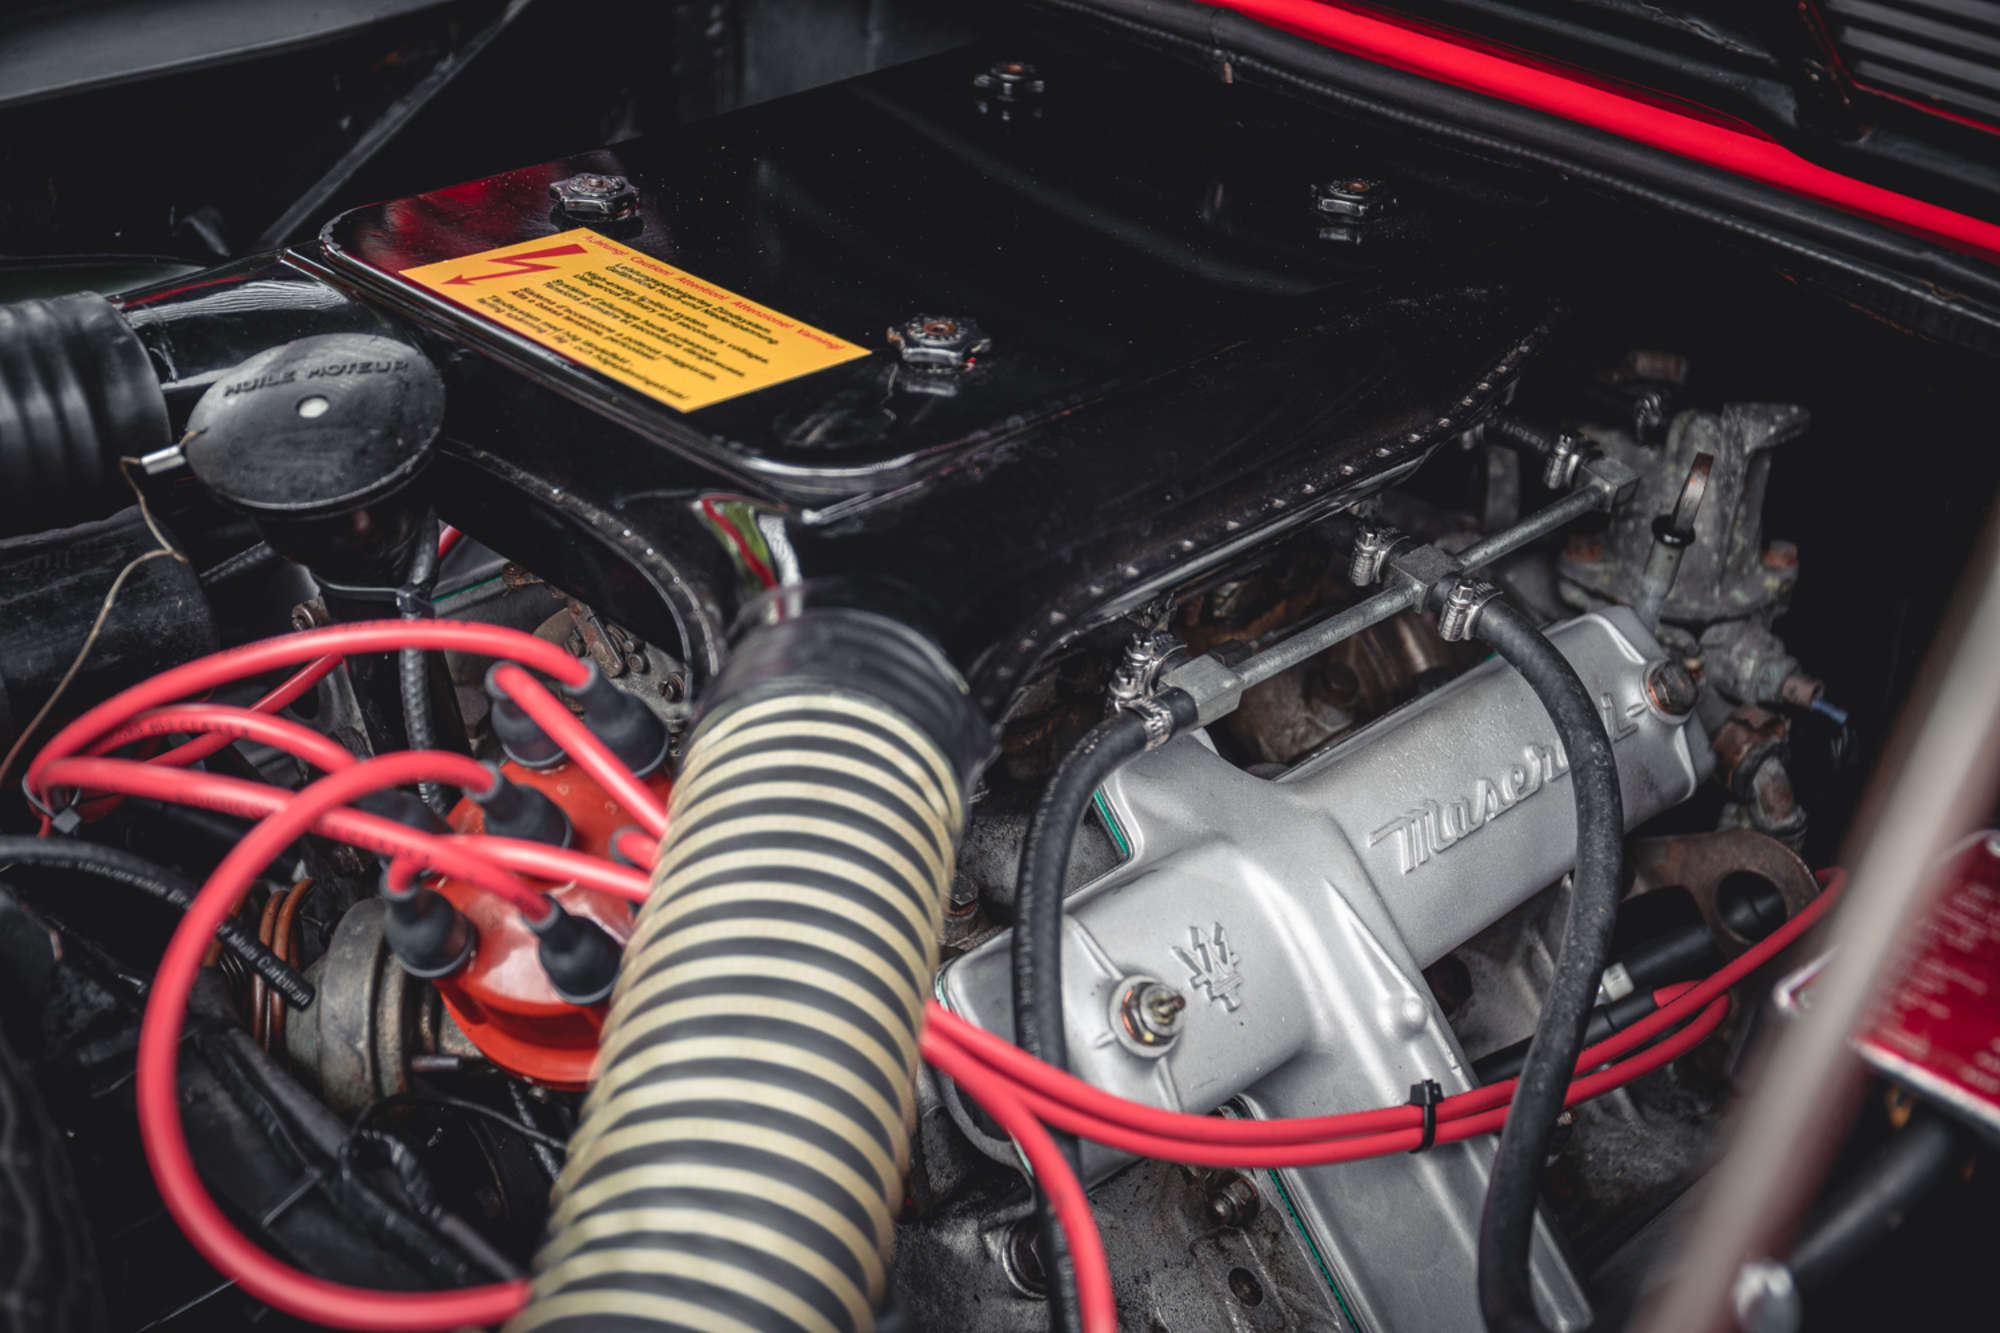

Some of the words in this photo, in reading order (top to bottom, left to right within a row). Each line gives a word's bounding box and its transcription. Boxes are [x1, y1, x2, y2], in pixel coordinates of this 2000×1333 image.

[629, 256, 675, 276] Caution!
[674, 276, 730, 300] Attention!
[730, 301, 795, 328] Attenzione!
[657, 312, 680, 322] and
[223, 371, 296, 398] HUILE
[307, 360, 408, 380] MOTEUR
